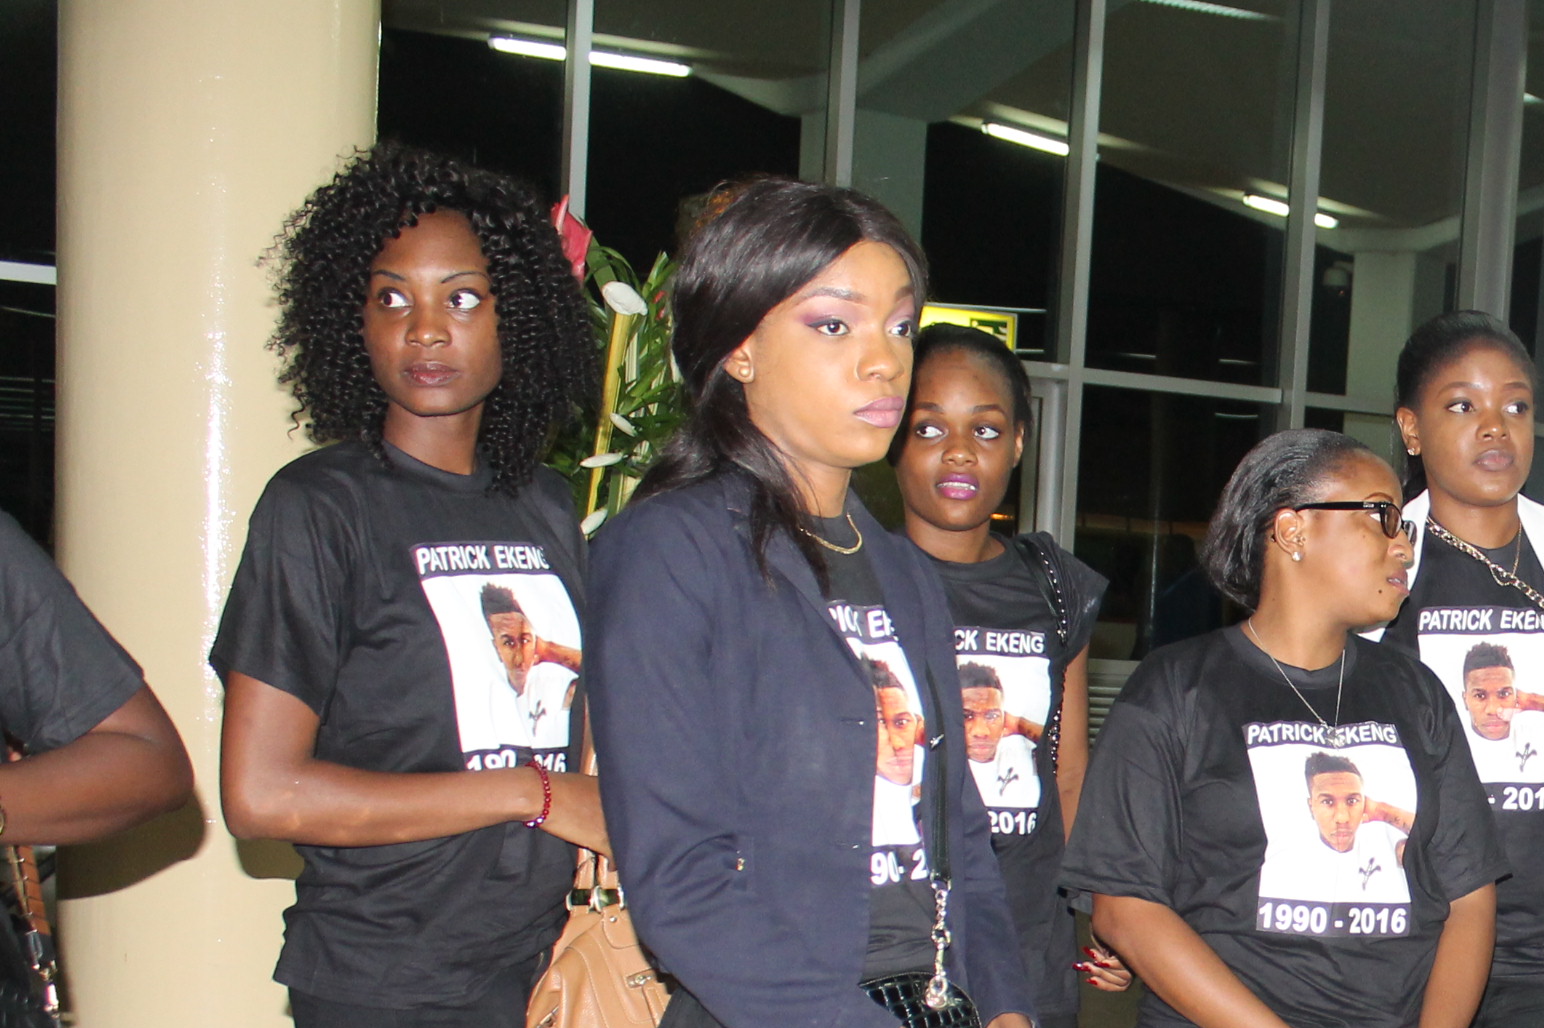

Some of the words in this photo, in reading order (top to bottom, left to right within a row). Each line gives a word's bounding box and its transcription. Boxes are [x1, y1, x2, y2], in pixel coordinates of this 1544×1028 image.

[415, 546, 491, 575] PATRICK
[1418, 608, 1493, 631] PATRICK
[985, 631, 1044, 654] EKENG
[1247, 724, 1326, 745] PATRICK
[987, 810, 1037, 835] 2016
[1258, 902, 1328, 934] 1990
[1348, 907, 1407, 934] 2016
